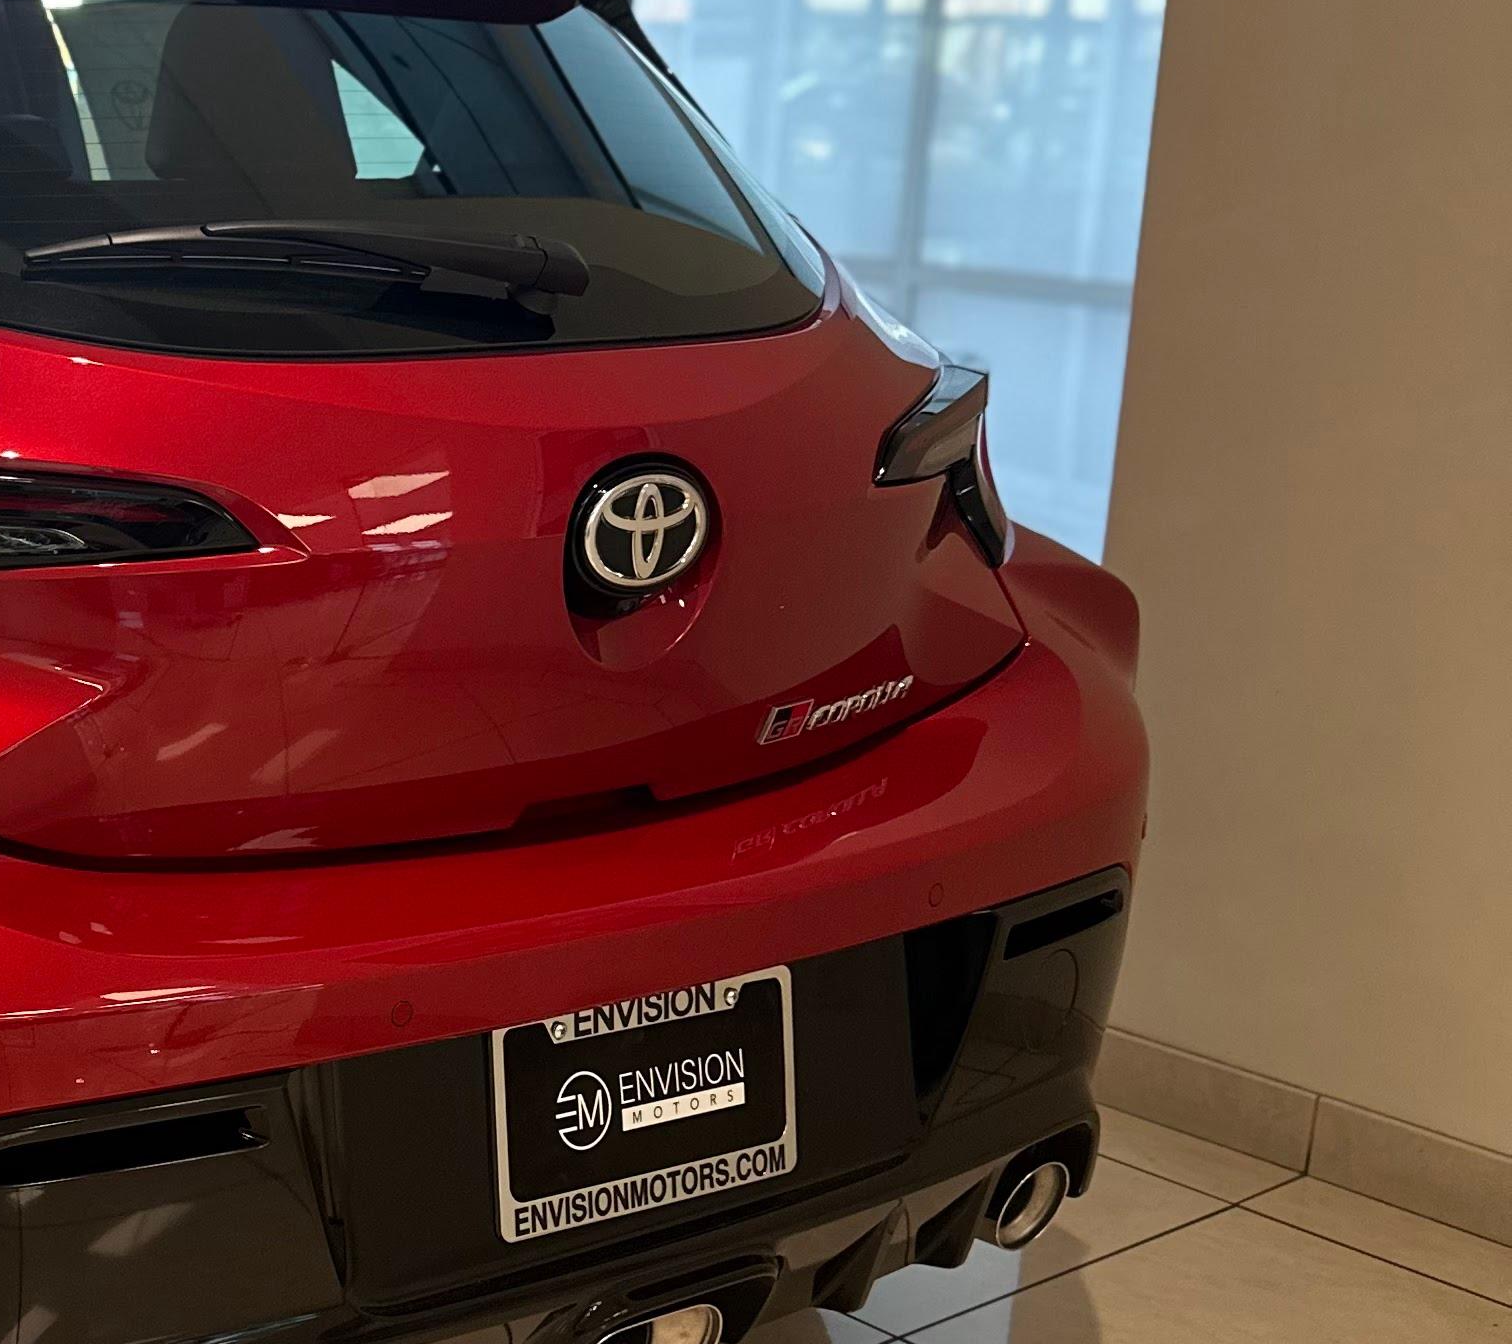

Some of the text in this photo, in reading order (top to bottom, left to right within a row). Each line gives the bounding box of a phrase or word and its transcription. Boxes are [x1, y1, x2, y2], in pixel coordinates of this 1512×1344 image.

[573, 982, 716, 1038] ENVISION
[619, 1048, 745, 1104] ENVISION
[632, 1089, 735, 1125] MOTORS
[514, 1143, 787, 1237] ENVISIONMOTORS.COM
